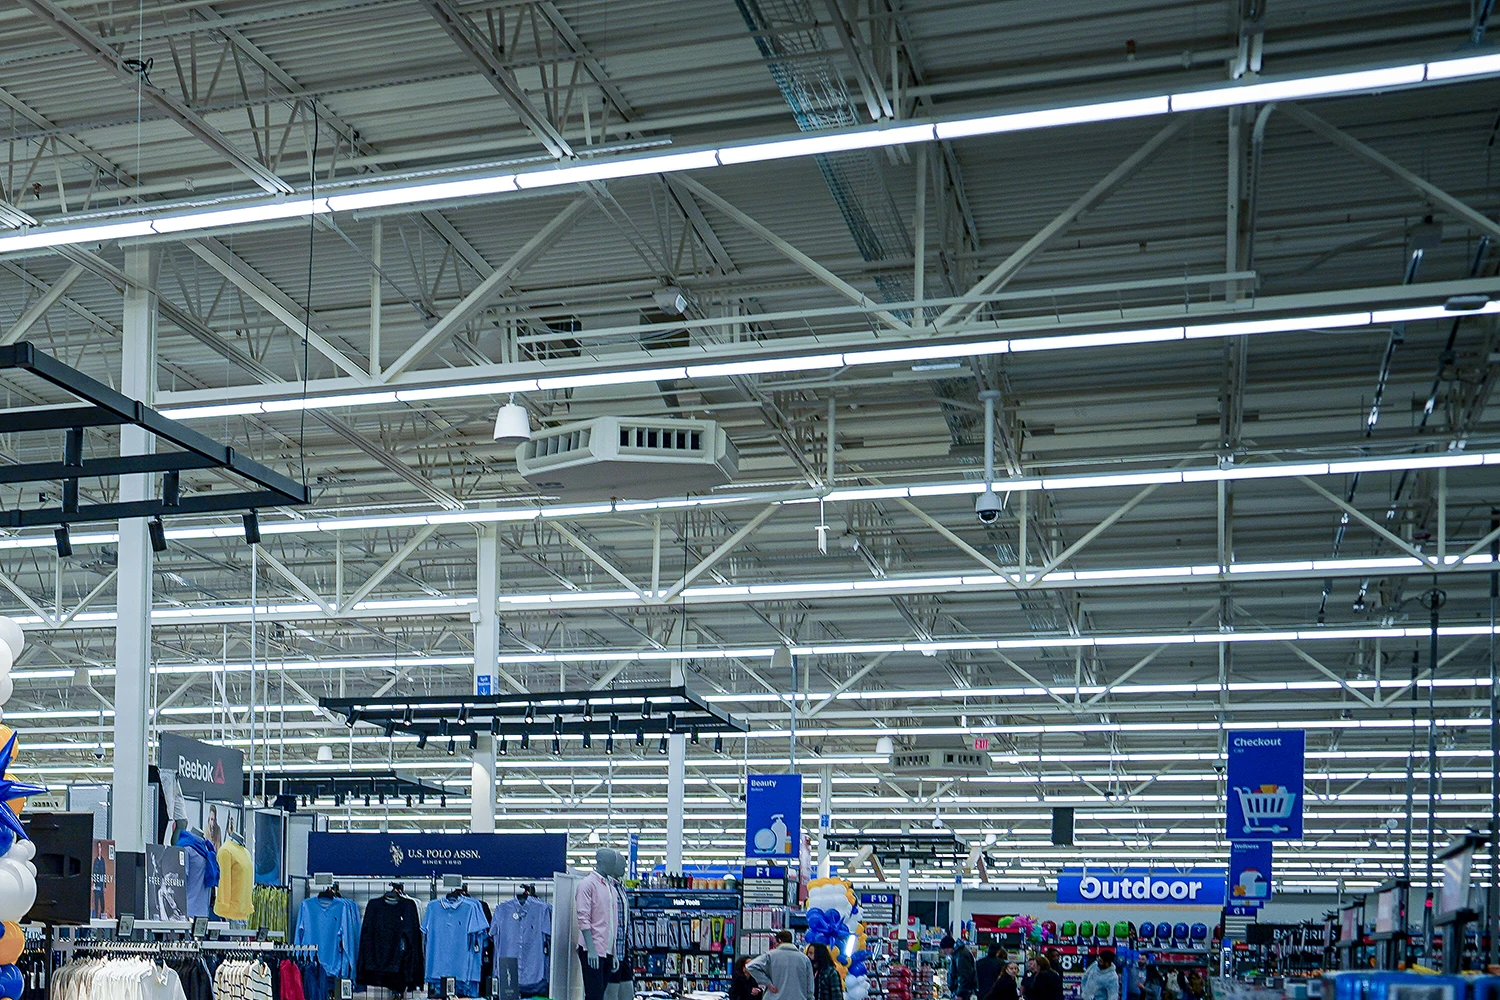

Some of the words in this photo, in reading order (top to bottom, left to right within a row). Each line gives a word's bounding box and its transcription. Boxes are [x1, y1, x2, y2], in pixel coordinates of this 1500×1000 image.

[975, 738, 989, 749] EXIT
[1233, 737, 1282, 747] Checkout
[178, 754, 214, 783] Reebok
[751, 780, 777, 788] Beauty
[407, 849, 424, 858] U.S.
[426, 849, 451, 859] POLO
[453, 849, 481, 859] ASSN.
[148, 876, 160, 886] FREE
[1079, 876, 1202, 900] Outdoor
[1273, 929, 1337, 940] BATERIS
